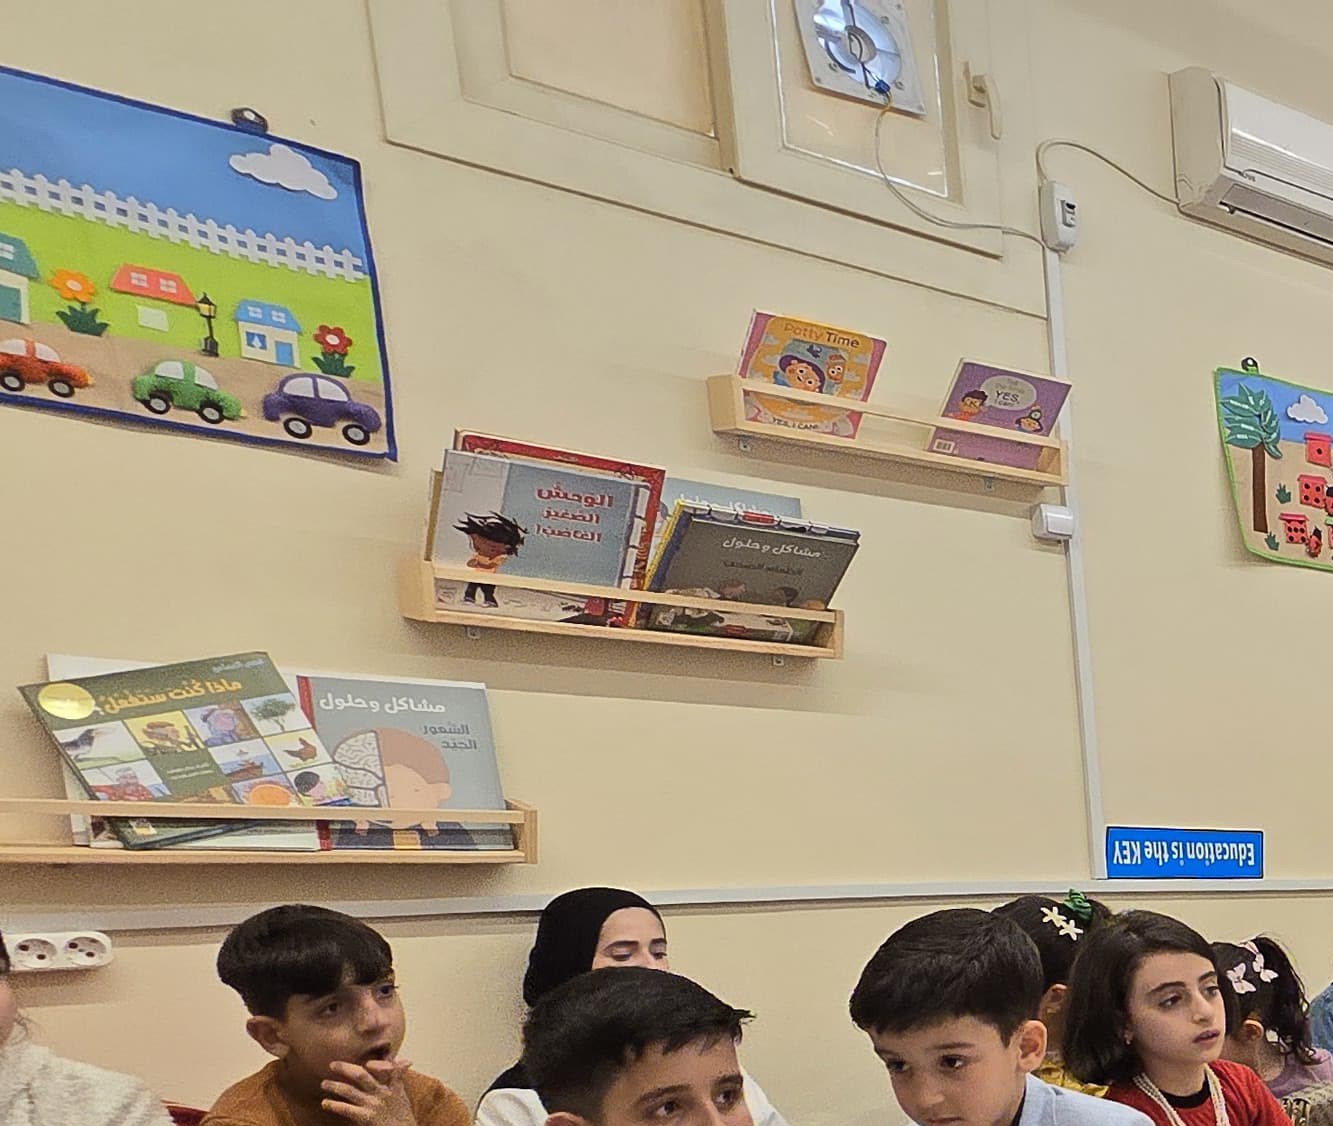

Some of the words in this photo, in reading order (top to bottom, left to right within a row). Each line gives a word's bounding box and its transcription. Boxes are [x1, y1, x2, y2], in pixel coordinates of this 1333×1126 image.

[784, 323, 822, 341] Potty
[826, 331, 860, 348] Time
[772, 544, 821, 558] مشاكل
[384, 697, 447, 714] مشاكل
[1113, 840, 1142, 866] KEY
[1144, 841, 1169, 867] the
[1172, 842, 1185, 867] is
[1186, 842, 1255, 867] Education
